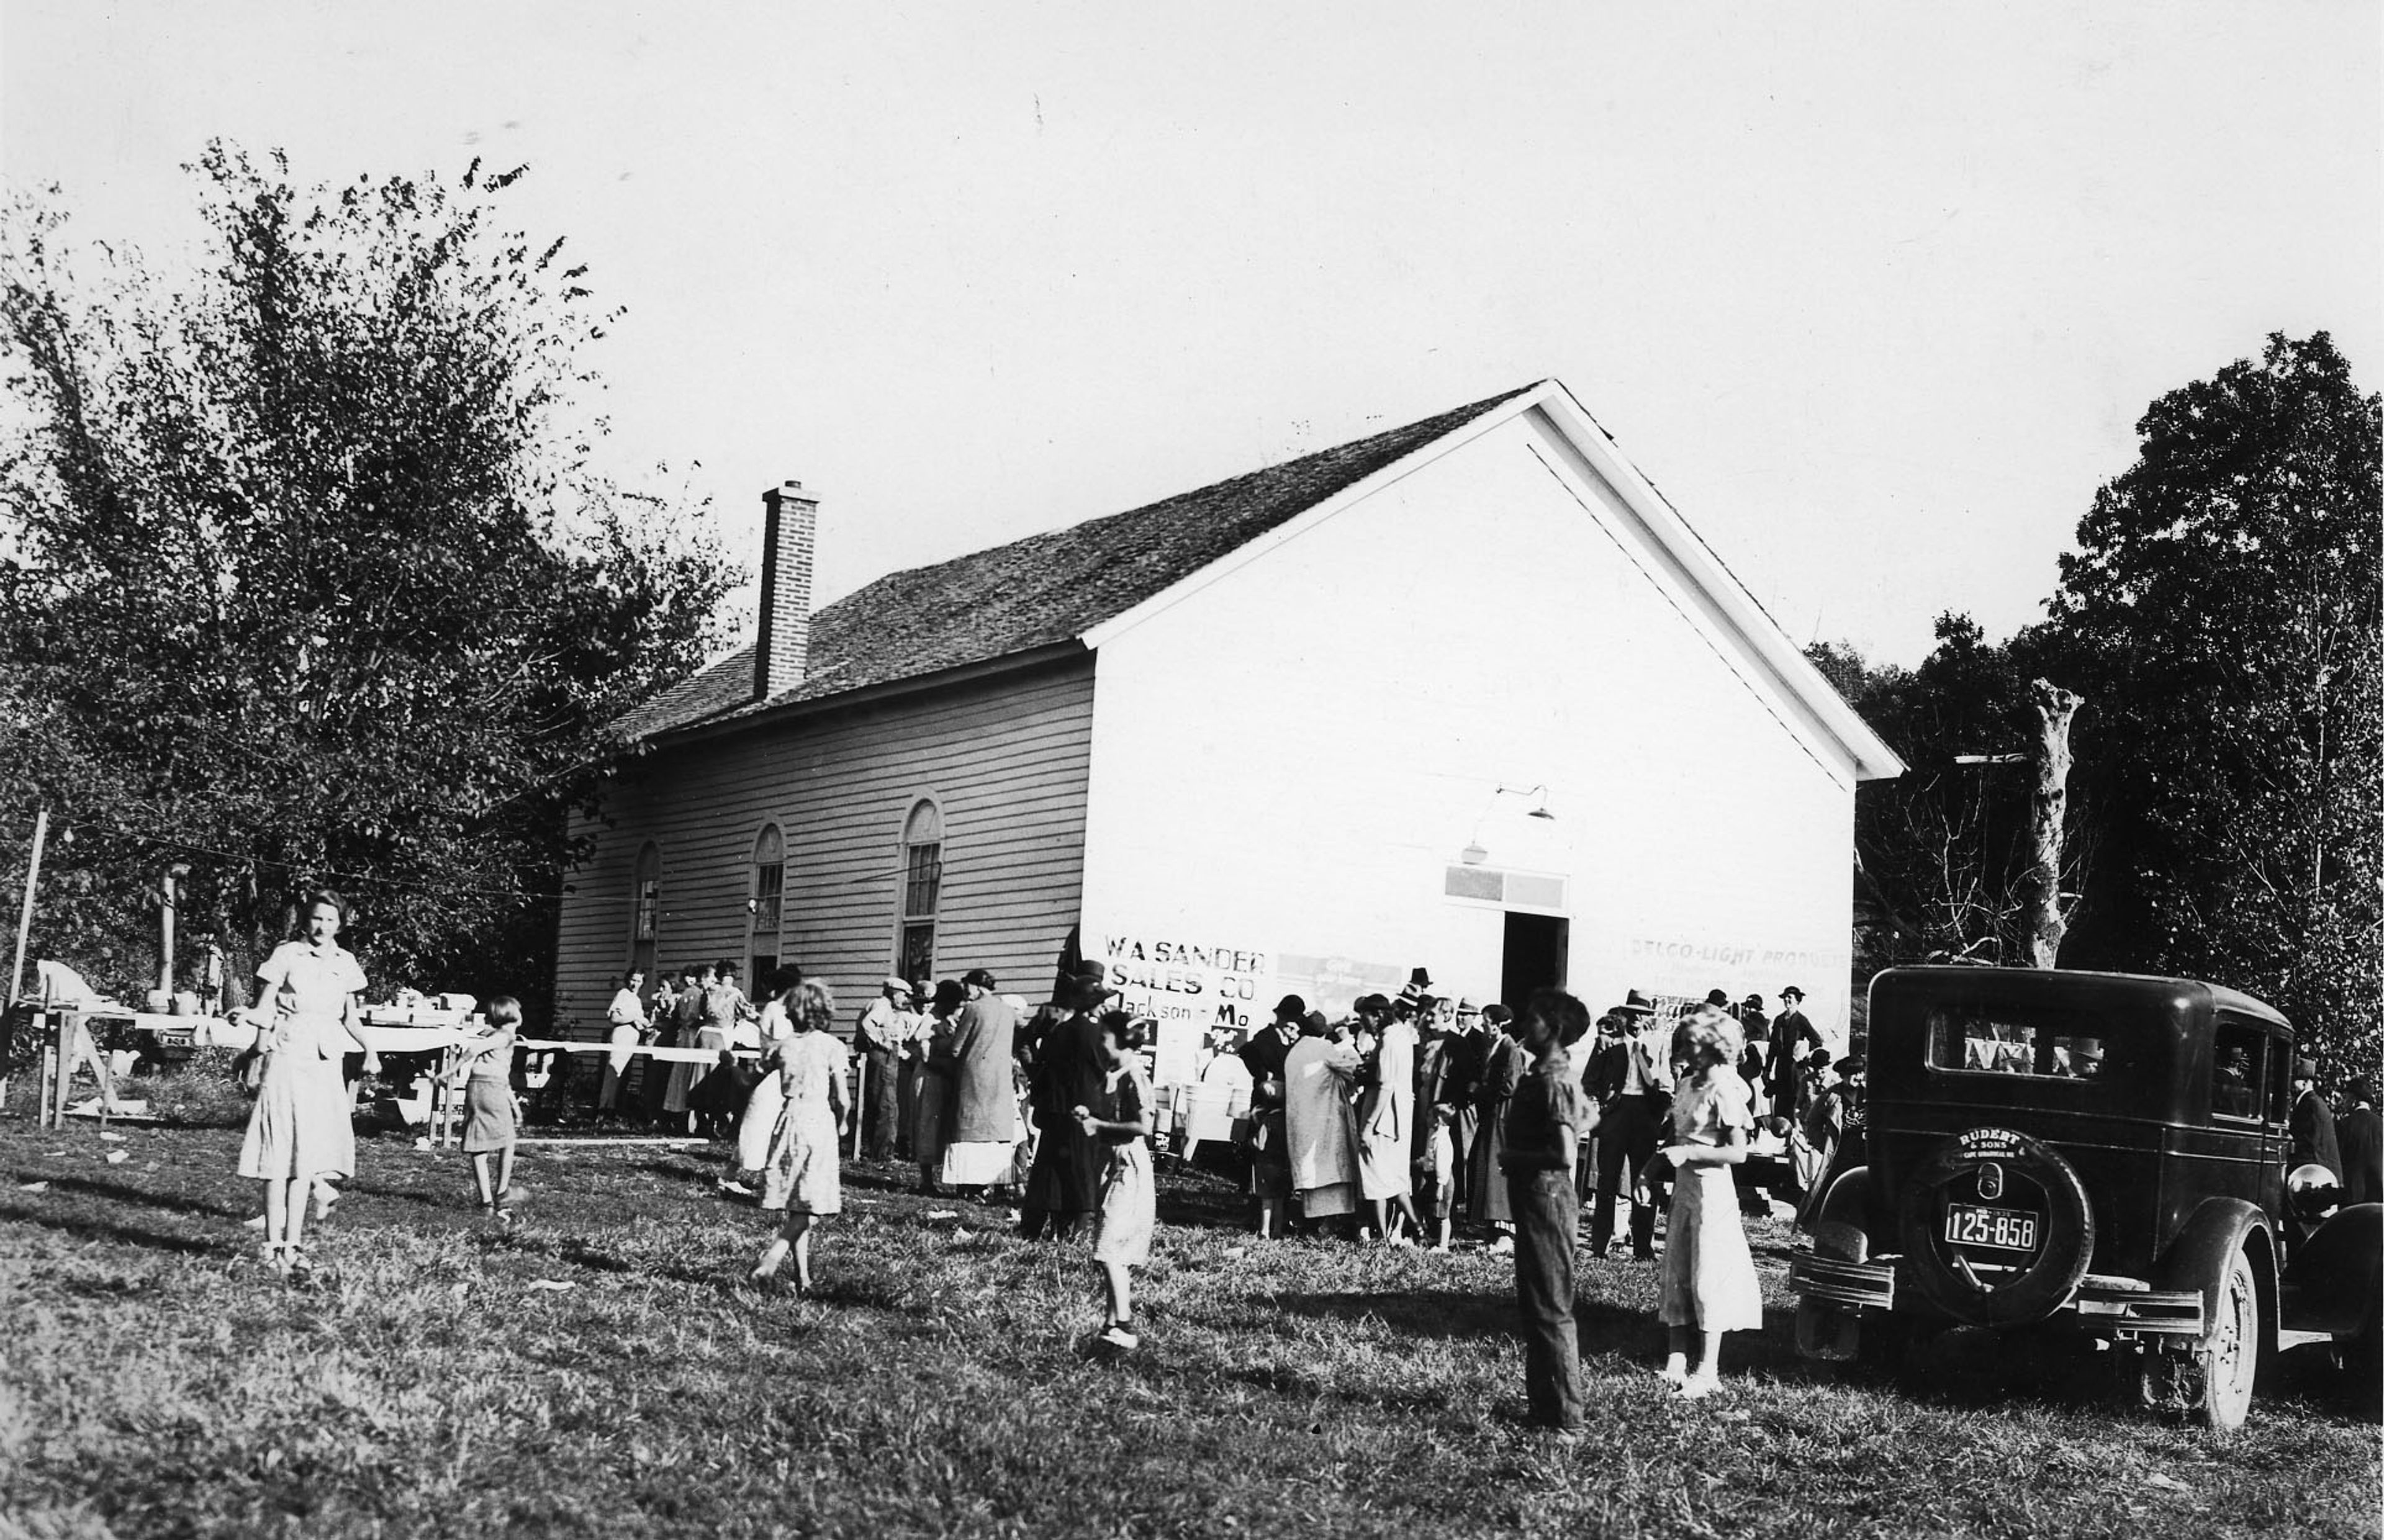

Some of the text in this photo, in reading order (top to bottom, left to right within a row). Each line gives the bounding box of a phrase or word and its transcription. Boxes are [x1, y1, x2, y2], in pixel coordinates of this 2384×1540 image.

[1111, 964, 1203, 994] SALES
[1959, 1128, 2020, 1146] RUDERT
[1952, 1212, 2034, 1248] 125-858
